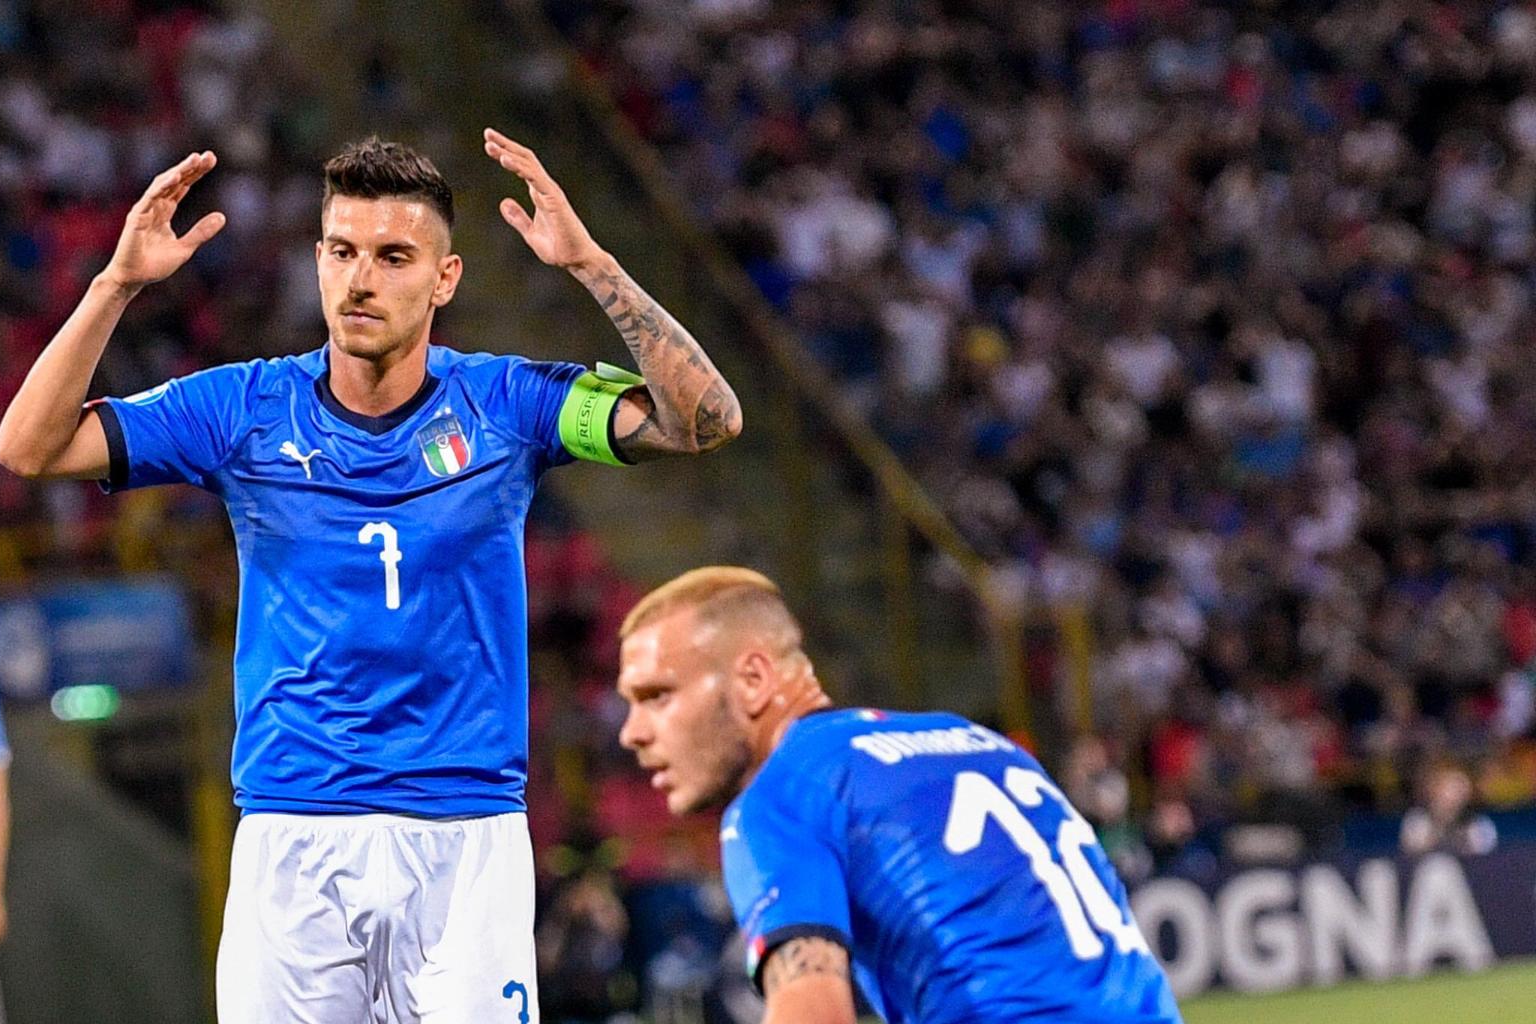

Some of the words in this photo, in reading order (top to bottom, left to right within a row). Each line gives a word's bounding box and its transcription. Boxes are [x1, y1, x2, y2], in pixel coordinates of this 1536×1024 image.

[358, 521, 402, 610] 7
[943, 766, 1151, 960] 12
[1129, 854, 1496, 1000] OGNA
